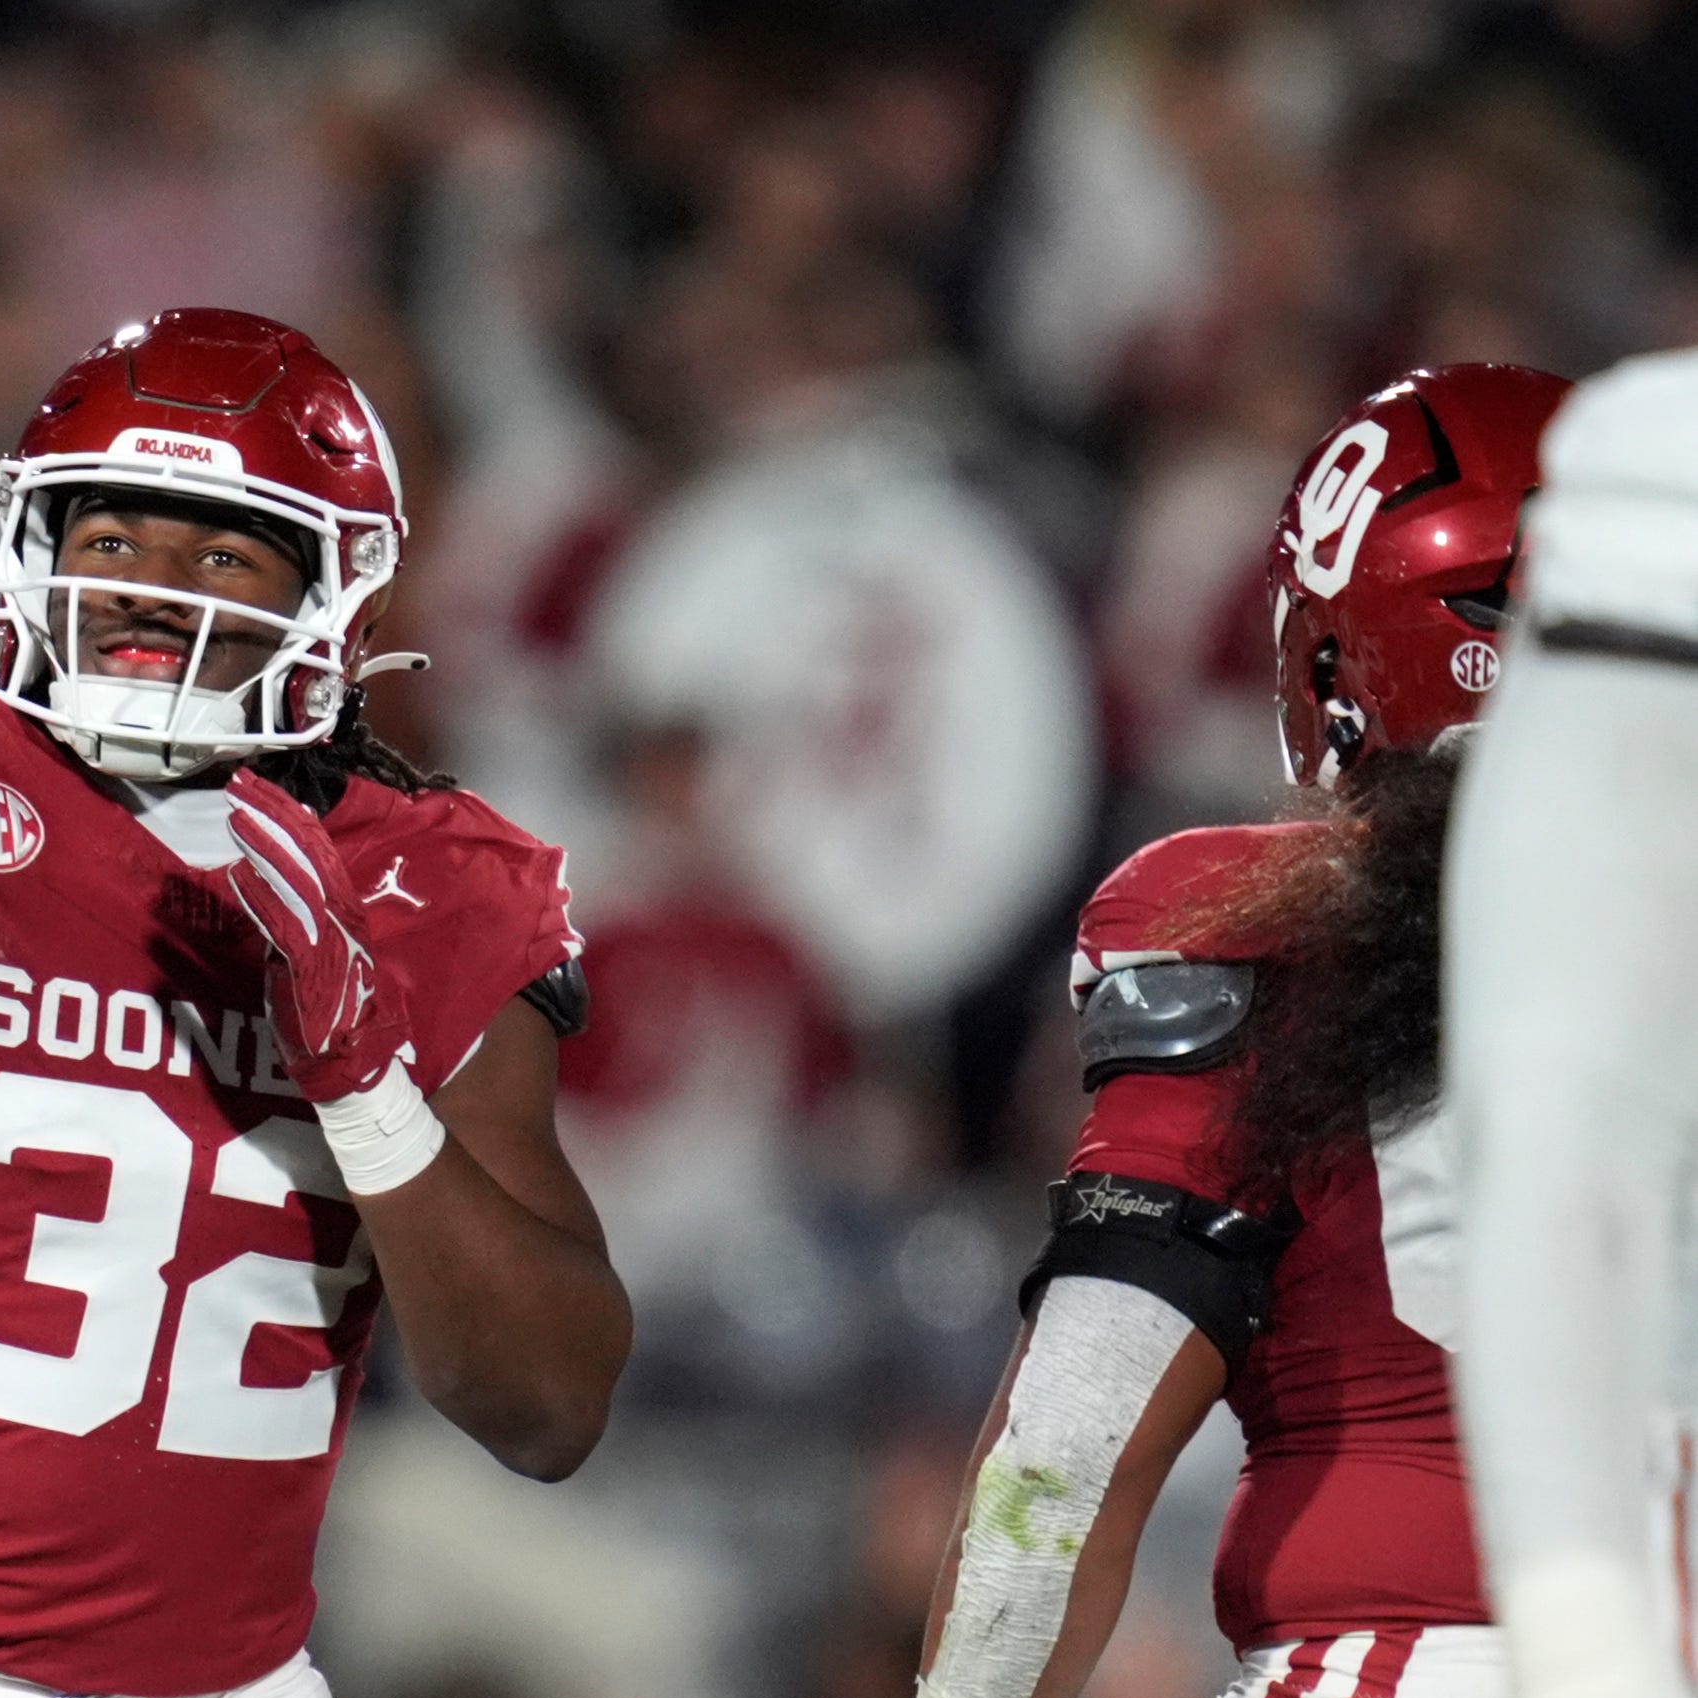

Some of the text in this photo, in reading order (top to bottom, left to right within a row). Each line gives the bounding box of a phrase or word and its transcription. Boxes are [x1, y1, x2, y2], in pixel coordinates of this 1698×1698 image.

[135, 438, 213, 464] OKLAHOMA
[1456, 645, 1496, 689] SEC
[1089, 1190, 1163, 1217] Douglas
